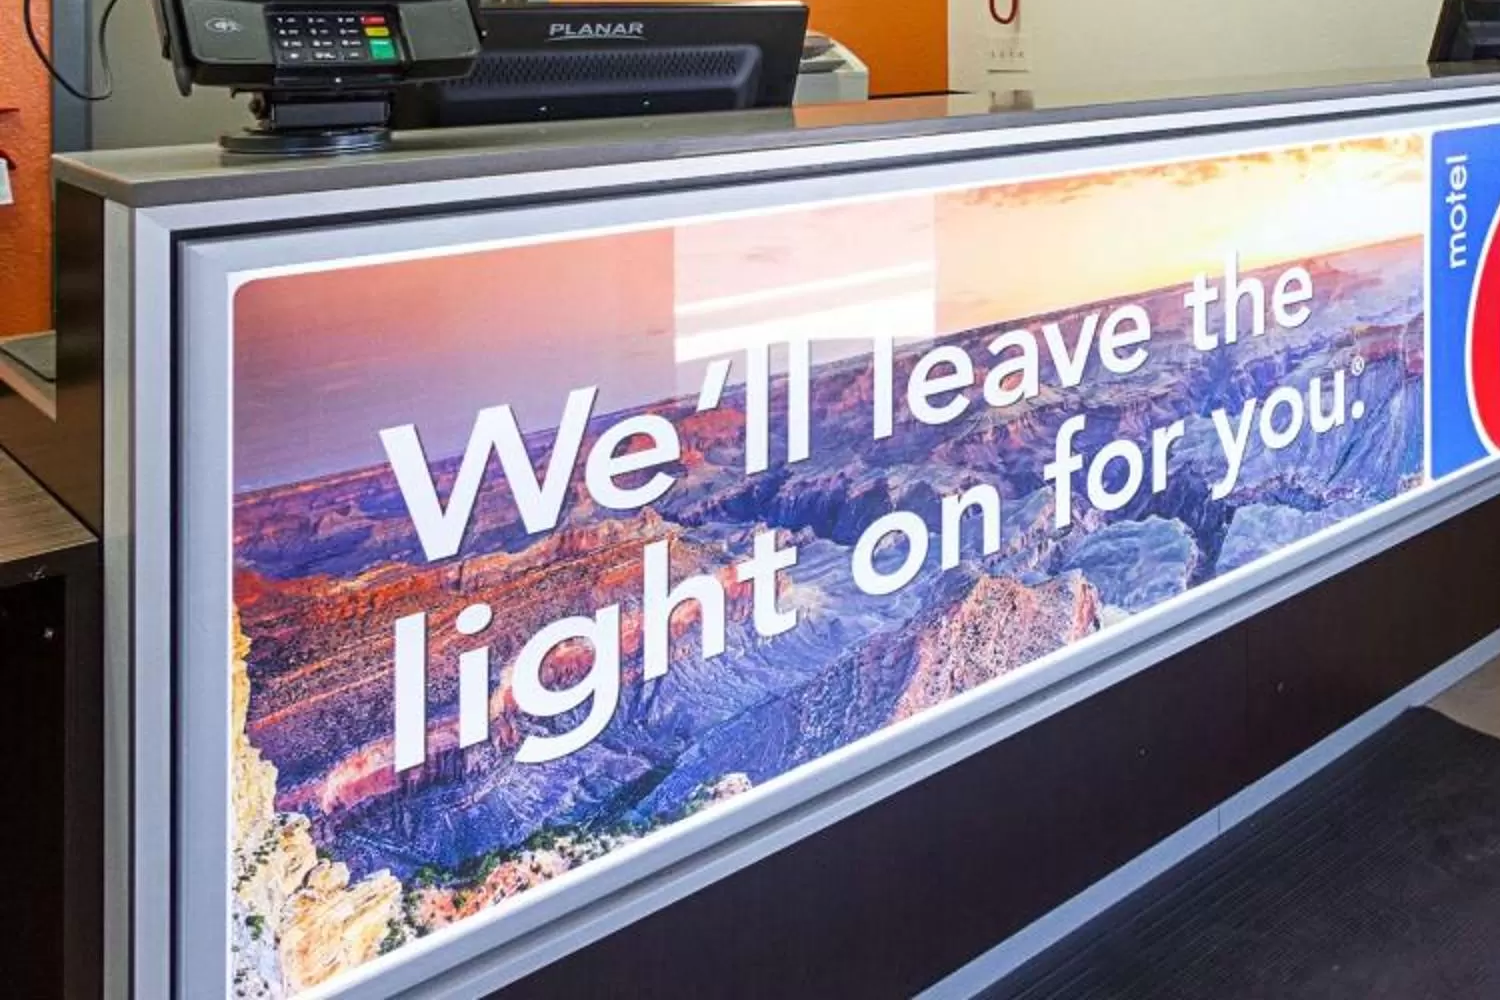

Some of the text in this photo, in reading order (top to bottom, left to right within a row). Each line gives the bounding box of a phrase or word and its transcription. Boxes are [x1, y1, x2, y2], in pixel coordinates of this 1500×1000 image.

[549, 22, 644, 37] PLANAR
[1445, 154, 1468, 268] motel
[379, 250, 1313, 562] We'll leave the
[394, 529, 797, 773] light
[850, 483, 1001, 596] on
[1044, 414, 1184, 529] for
